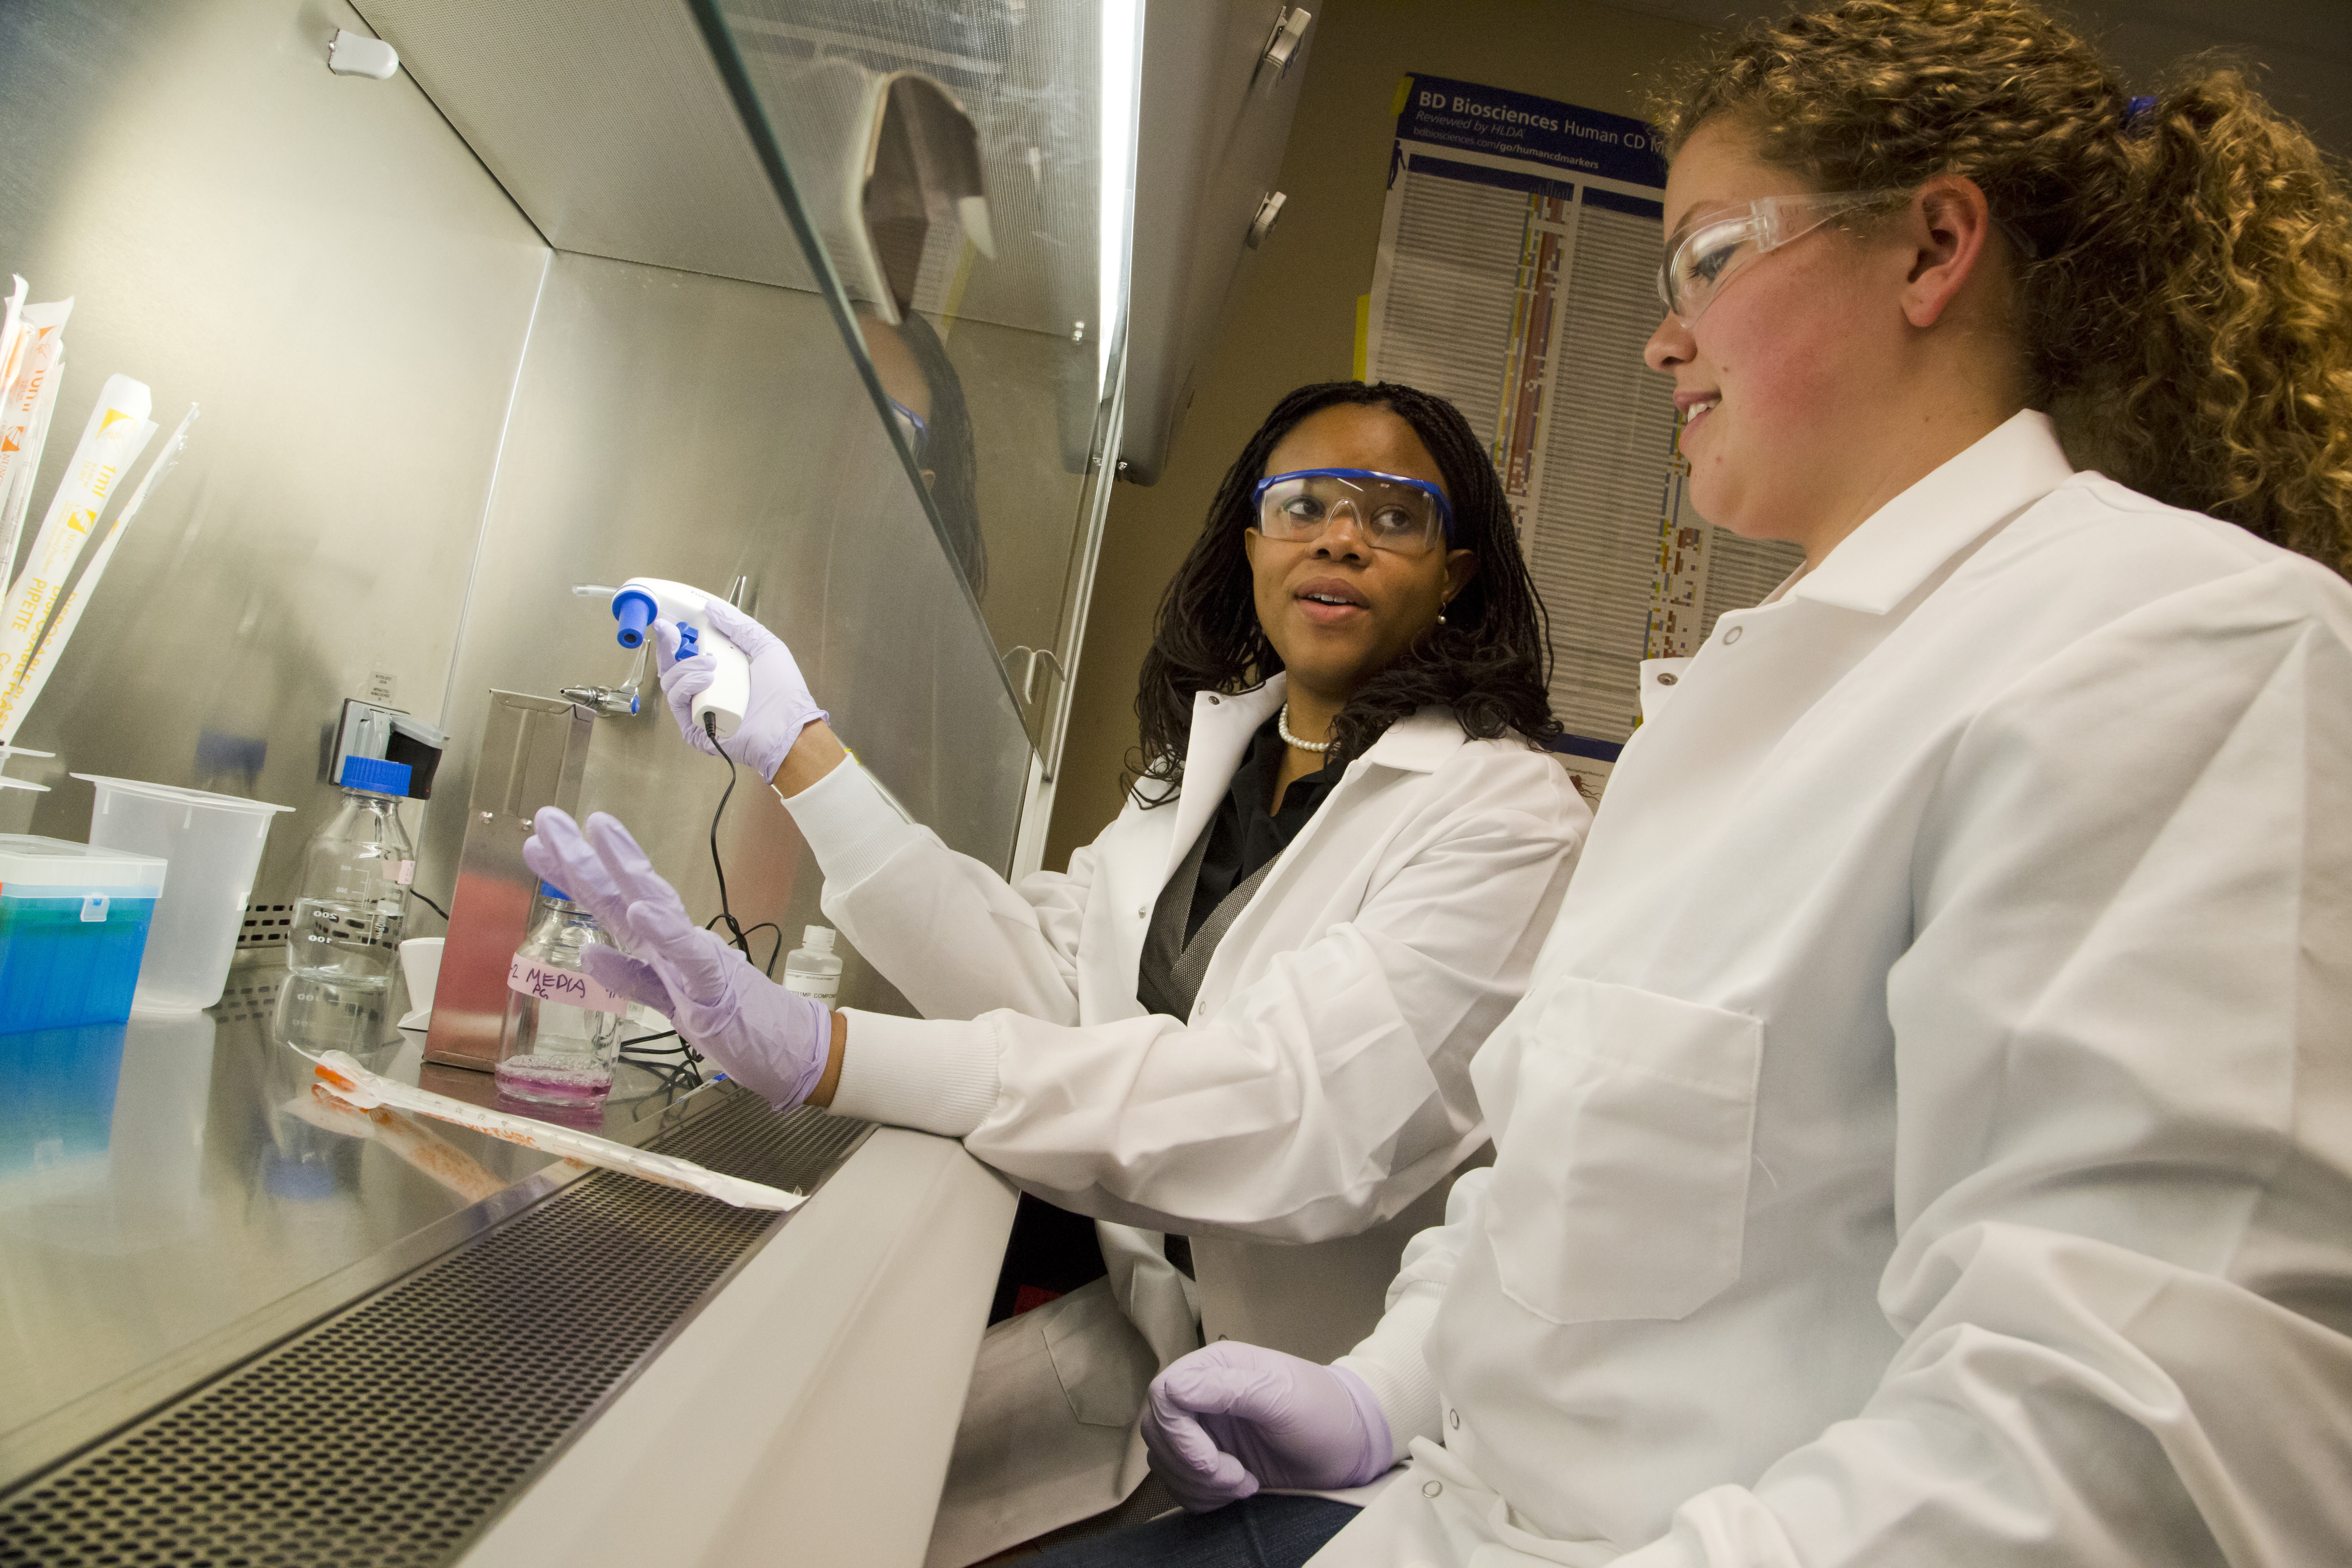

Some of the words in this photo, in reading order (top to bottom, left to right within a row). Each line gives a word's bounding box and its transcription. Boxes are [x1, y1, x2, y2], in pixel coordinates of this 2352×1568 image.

[1416, 110, 1471, 129] Reviewed
[1474, 121, 1489, 134] by
[1491, 124, 1524, 138] HLDA
[1419, 91, 1446, 109] BD
[1452, 97, 1558, 131] Biosciences
[1564, 119, 1618, 144] Human
[1624, 133, 1645, 149] CD
[1414, 127, 1599, 169] bdbiosciences.com/go/humancdmarkers
[11, 577, 48, 633] PIPETTE
[526, 968, 586, 998] MEDIA
